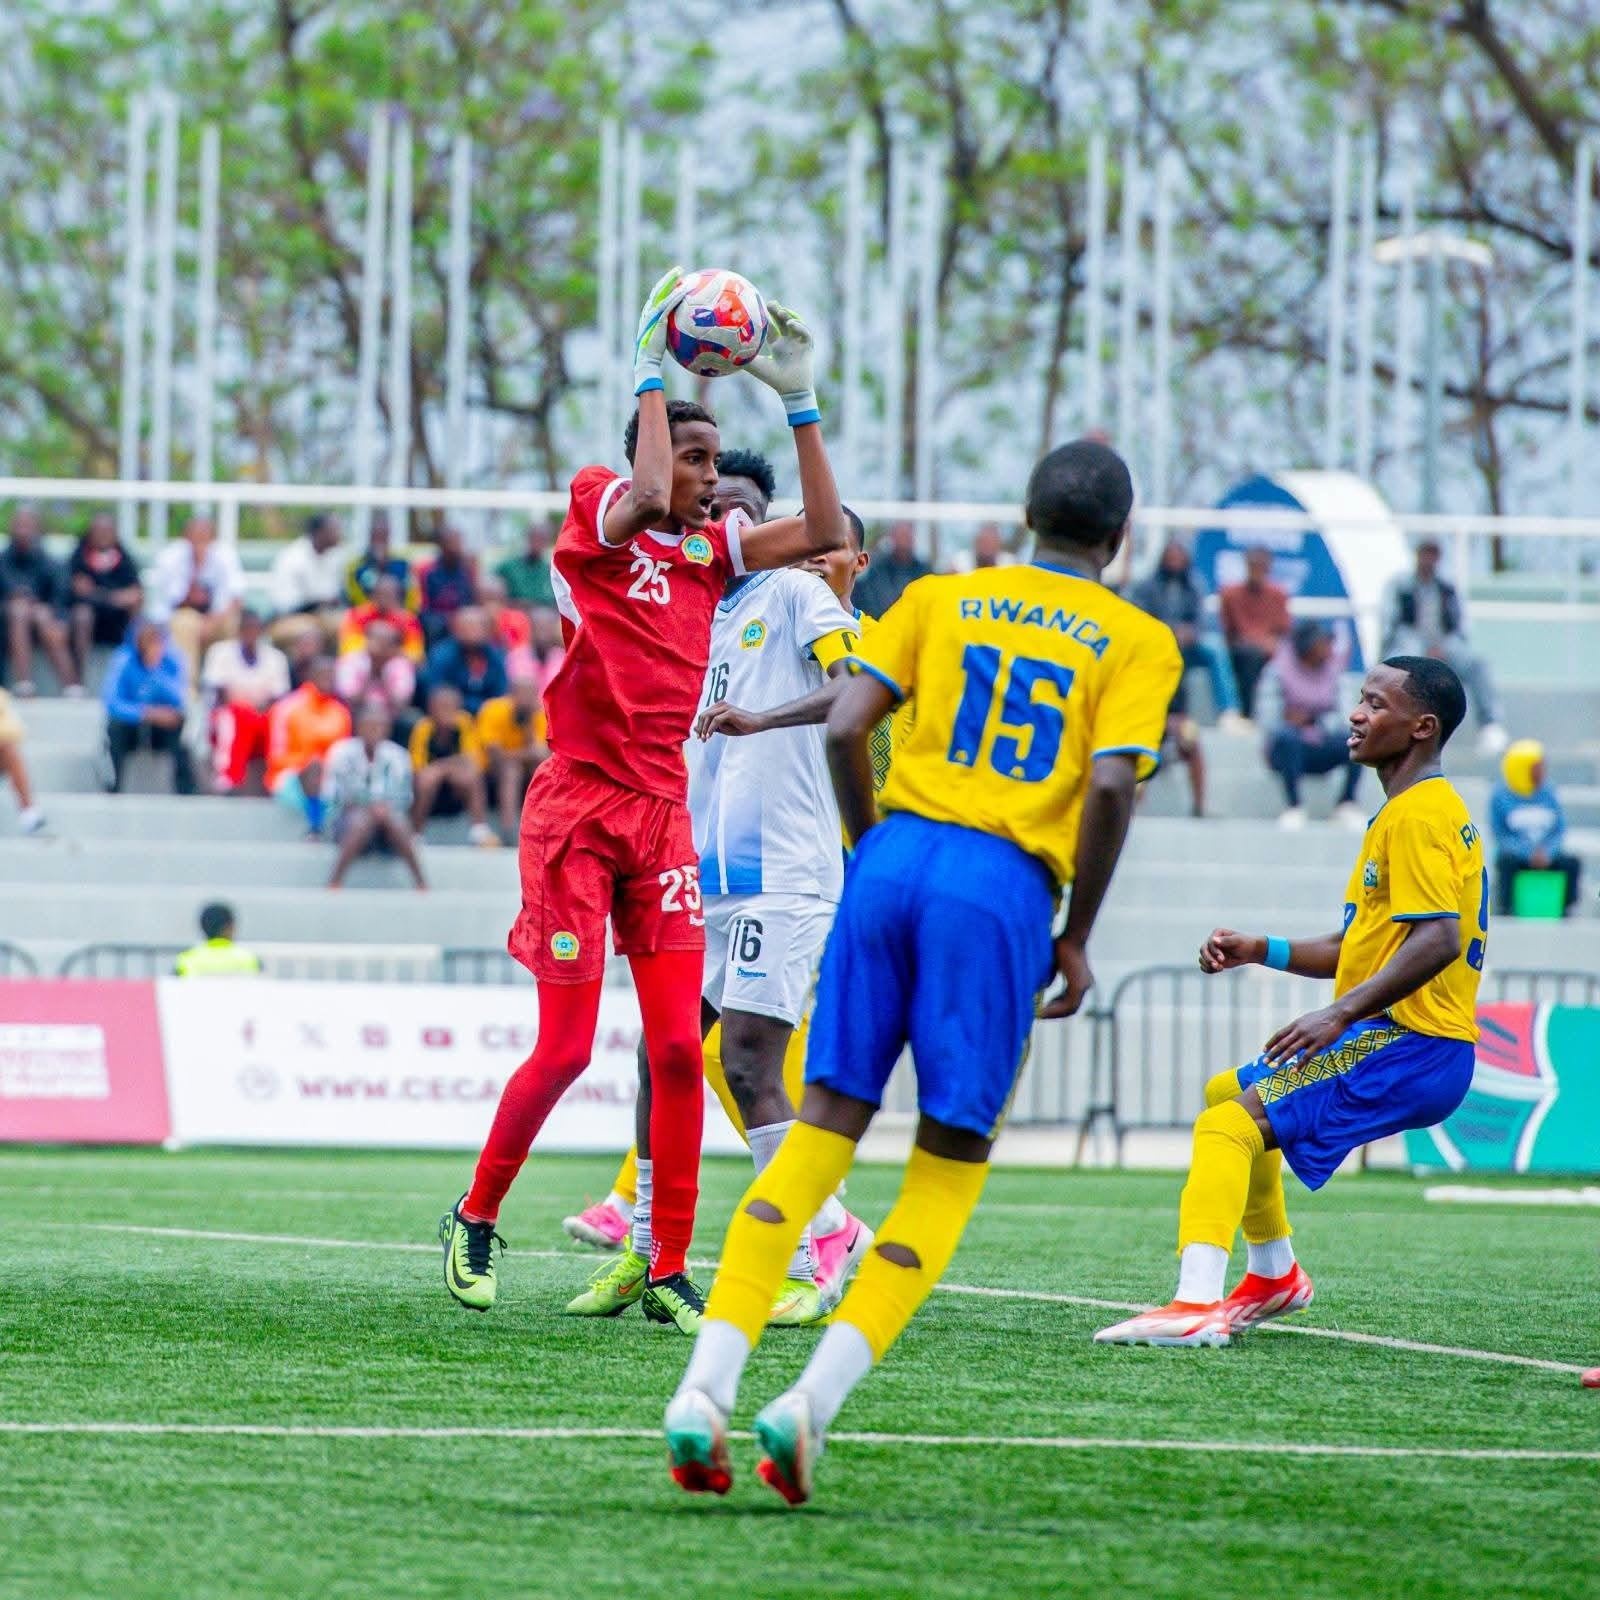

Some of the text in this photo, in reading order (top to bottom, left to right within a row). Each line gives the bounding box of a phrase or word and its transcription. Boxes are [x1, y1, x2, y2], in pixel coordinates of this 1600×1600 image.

[627, 557, 673, 605] 25
[705, 662, 730, 707] 16
[947, 643, 1076, 783] 15
[658, 865, 702, 912] 25
[731, 918, 764, 962] 16
